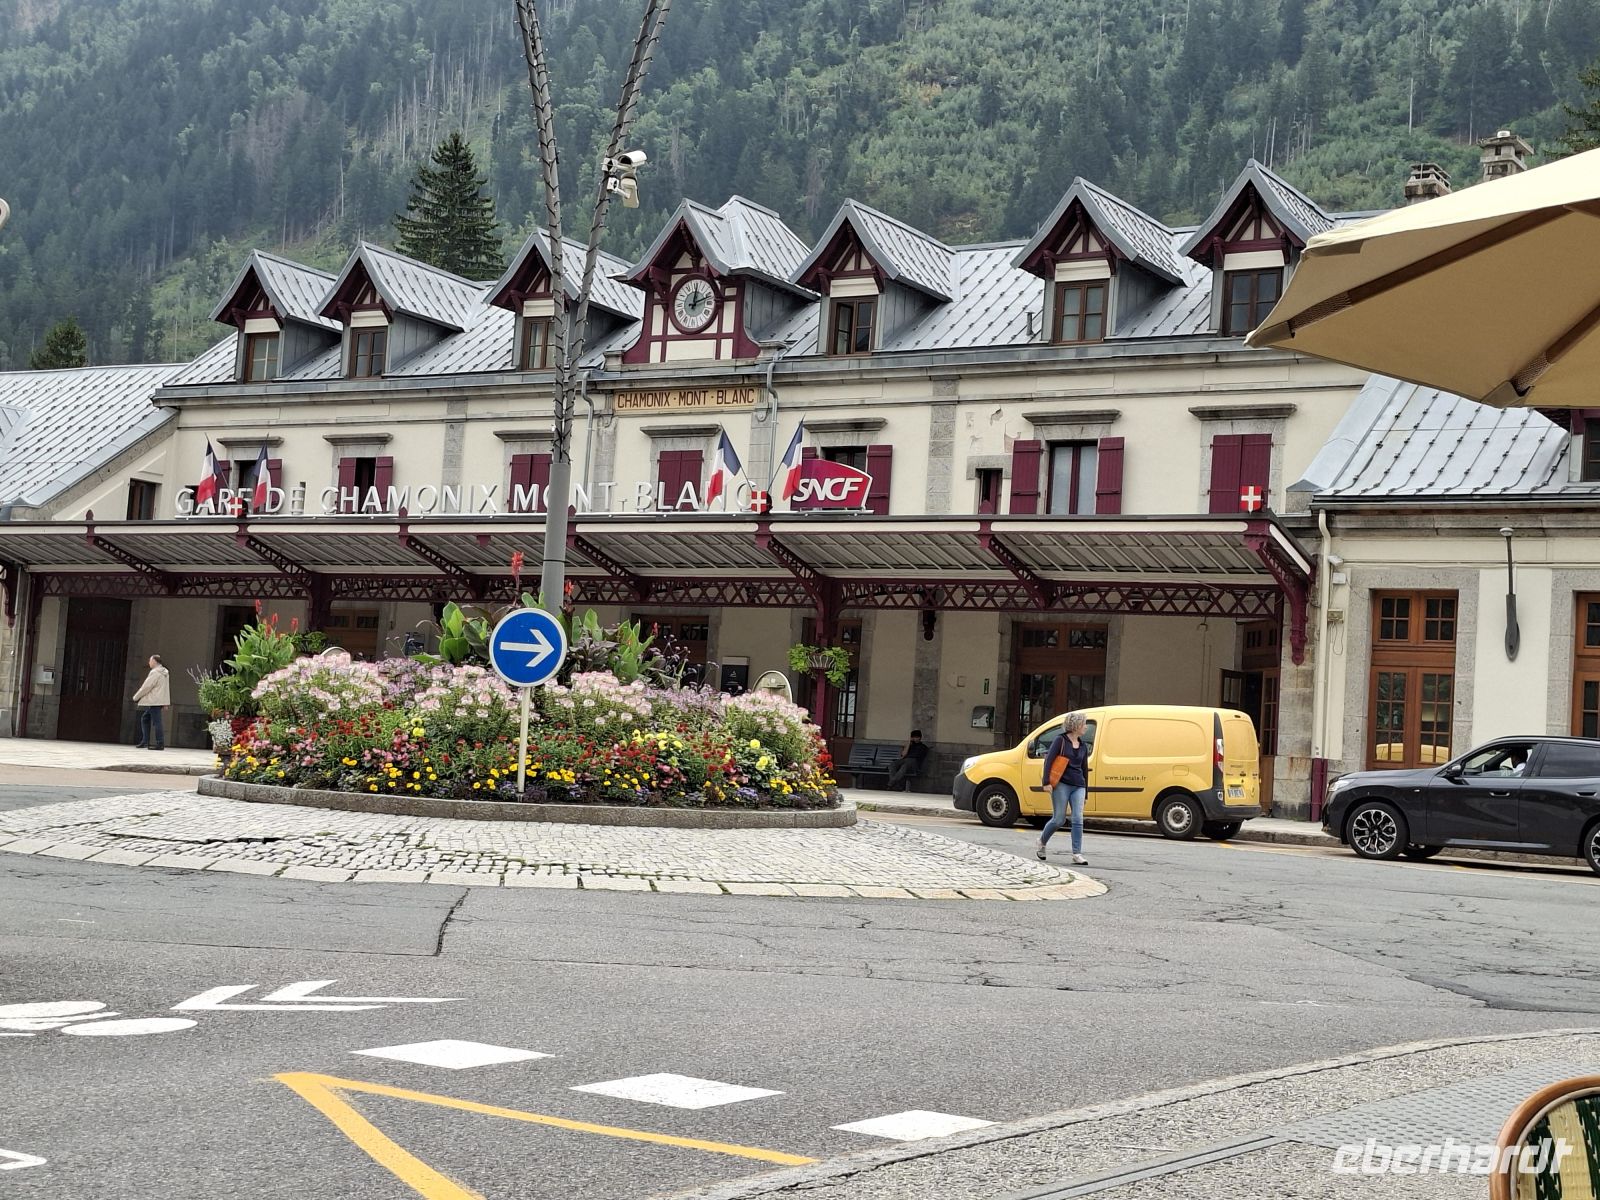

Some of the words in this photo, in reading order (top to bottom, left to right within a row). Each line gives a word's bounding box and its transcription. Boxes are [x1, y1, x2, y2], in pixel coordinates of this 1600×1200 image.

[617, 392, 670, 408] CHAMONIX
[678, 390, 708, 406] MONT
[716, 388, 755, 405] BLANC
[174, 487, 254, 514] GARE
[265, 486, 304, 514] DE
[320, 484, 497, 514] CHAMONIX
[513, 482, 618, 512] MNT
[792, 477, 864, 502] SNCF
